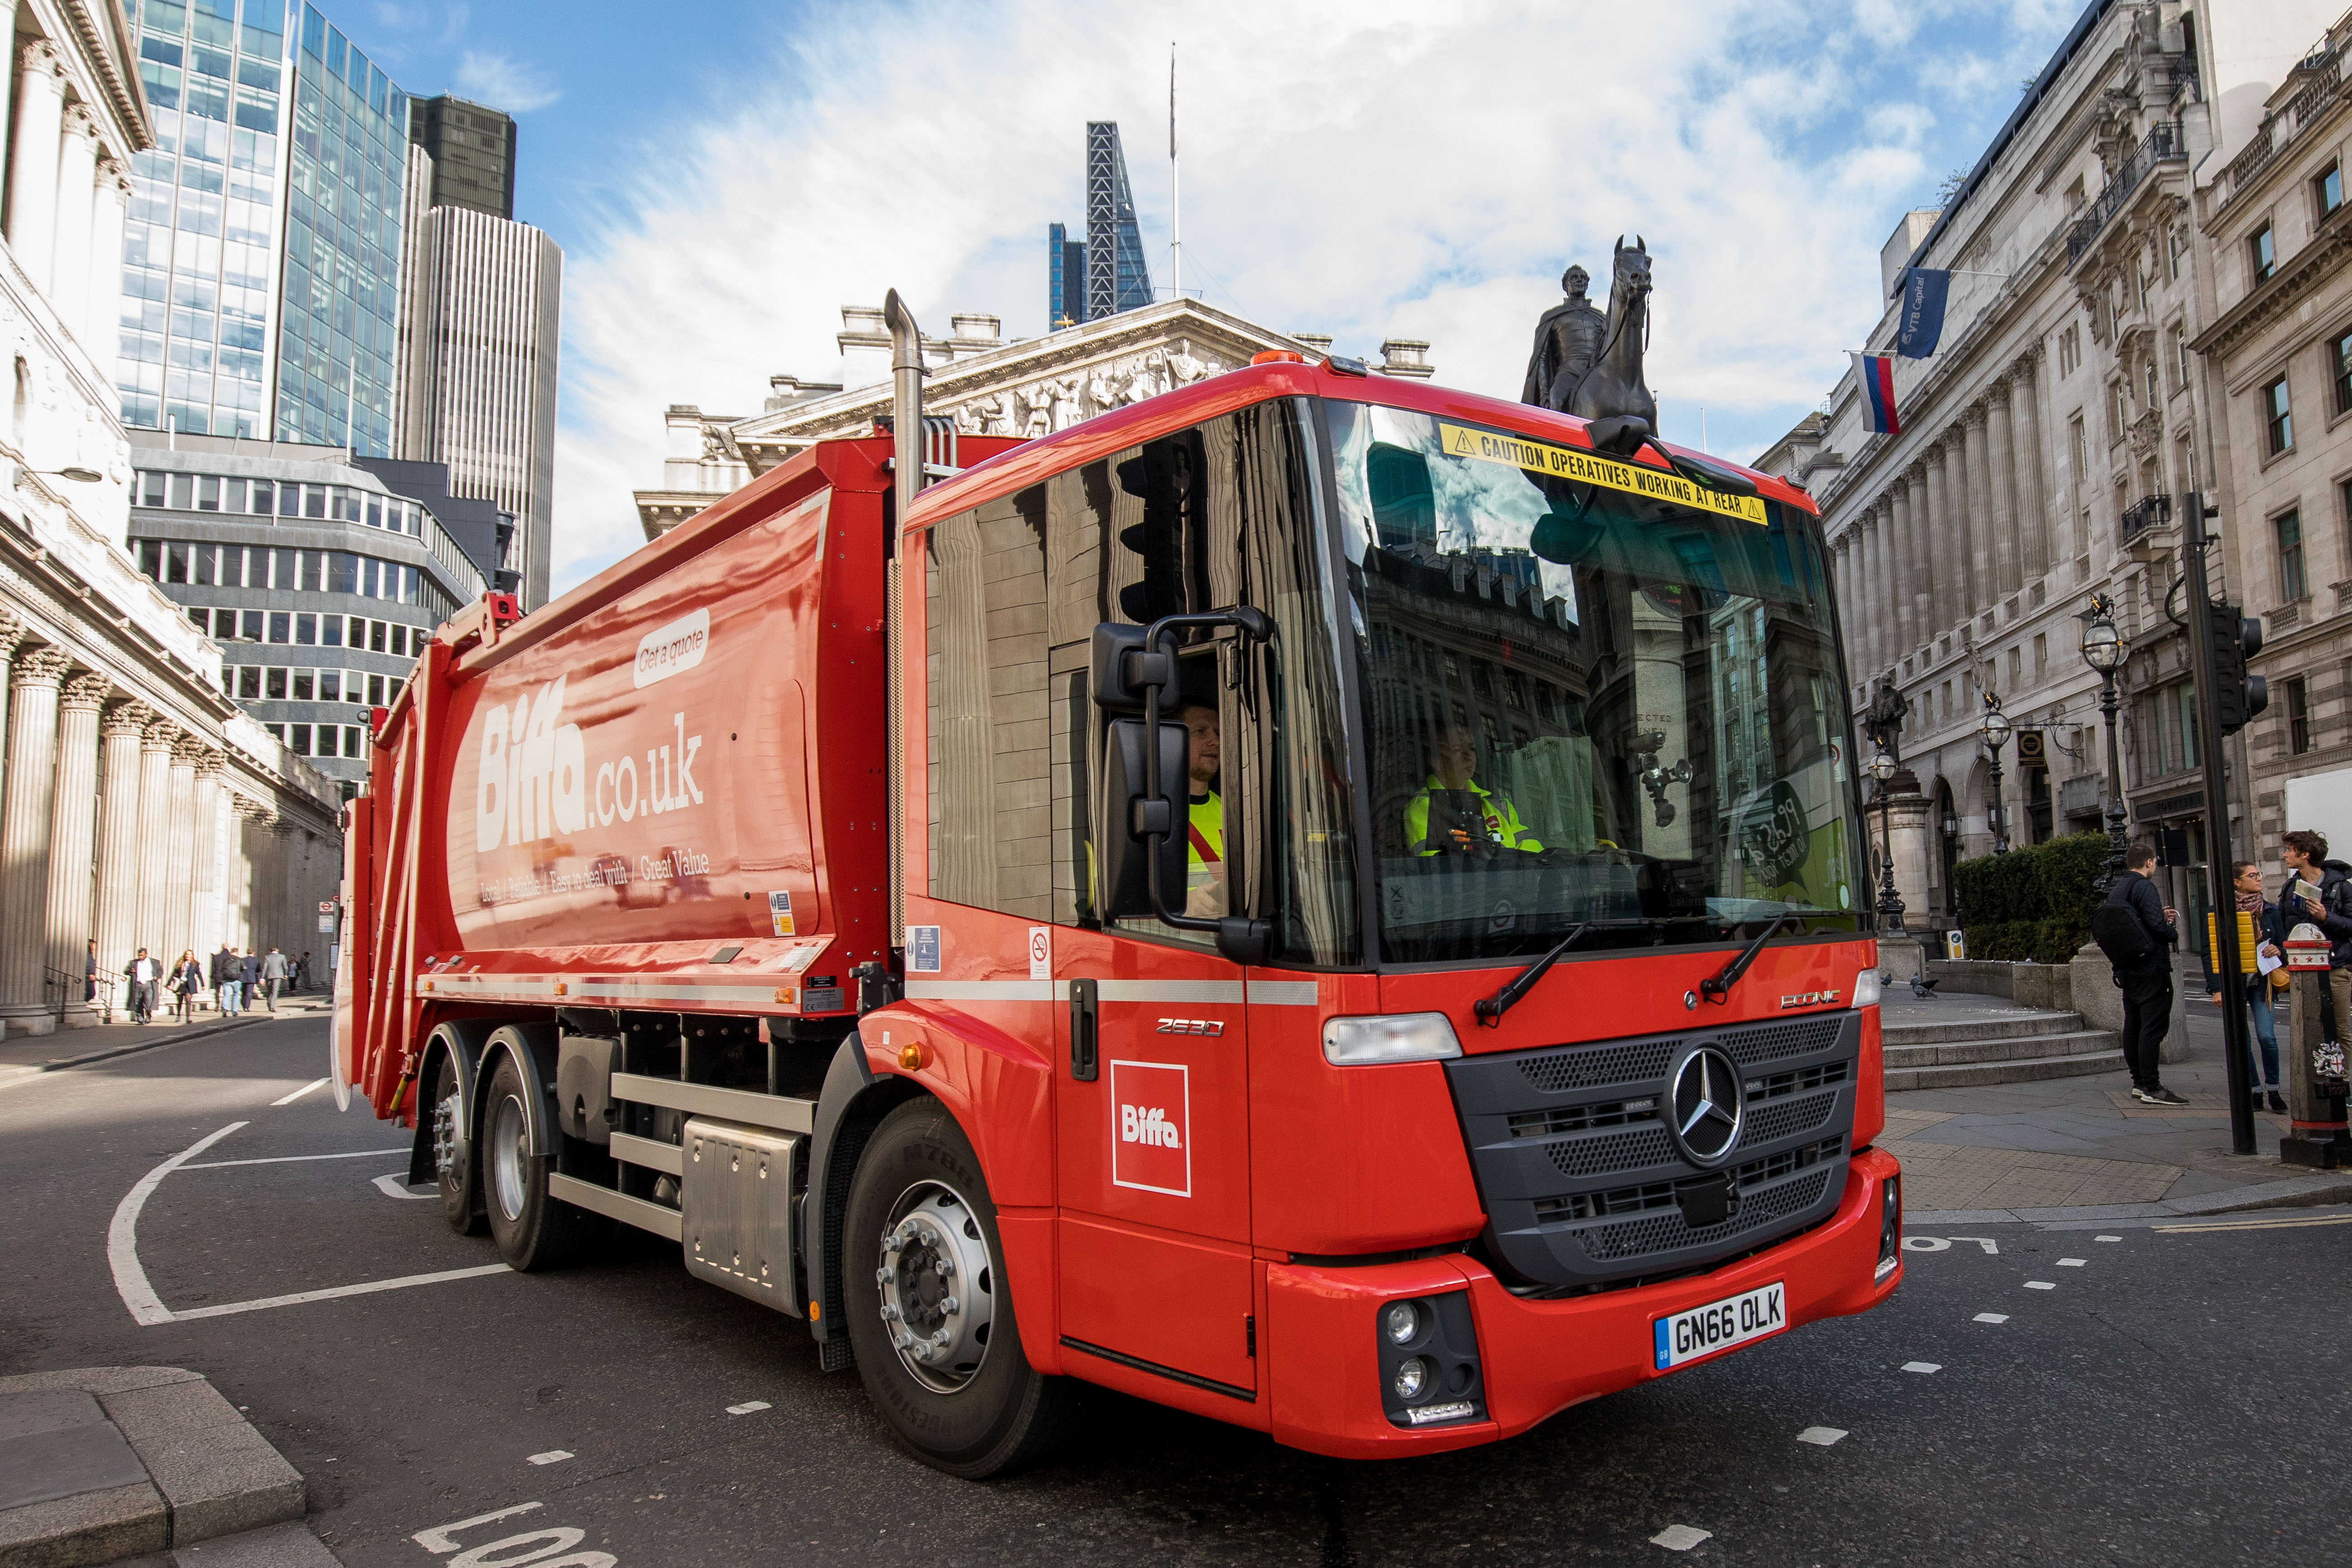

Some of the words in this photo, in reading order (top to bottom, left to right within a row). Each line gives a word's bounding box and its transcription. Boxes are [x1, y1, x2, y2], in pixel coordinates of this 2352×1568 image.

[1913, 276, 1925, 310] Capital
[1908, 311, 1920, 332] VTB
[1481, 436, 1545, 468] CAUTION
[1551, 452, 1631, 487] OPERATIVES
[1636, 471, 1691, 501] WORKING
[1696, 488, 1711, 505] AT
[1713, 492, 1742, 514] REAR
[639, 645, 659, 673] Get
[660, 646, 667, 664] a
[670, 628, 703, 666] quote
[1637, 714, 1672, 722] ECTED
[477, 673, 703, 853] Biffa.co.uk
[481, 880, 500, 902] Local
[508, 874, 541, 899] Reliable
[550, 871, 572, 897] Easy
[574, 872, 581, 890] to
[584, 863, 603, 887] deal
[605, 860, 628, 886] with
[640, 852, 673, 881] Great
[673, 848, 710, 876] Value
[1780, 990, 1840, 1009] ECONIC
[1157, 1018, 1224, 1037] 2630
[1676, 1304, 1735, 1354] GN66
[1741, 1289, 1781, 1333] OLK
[1660, 1350, 1668, 1360] GB
